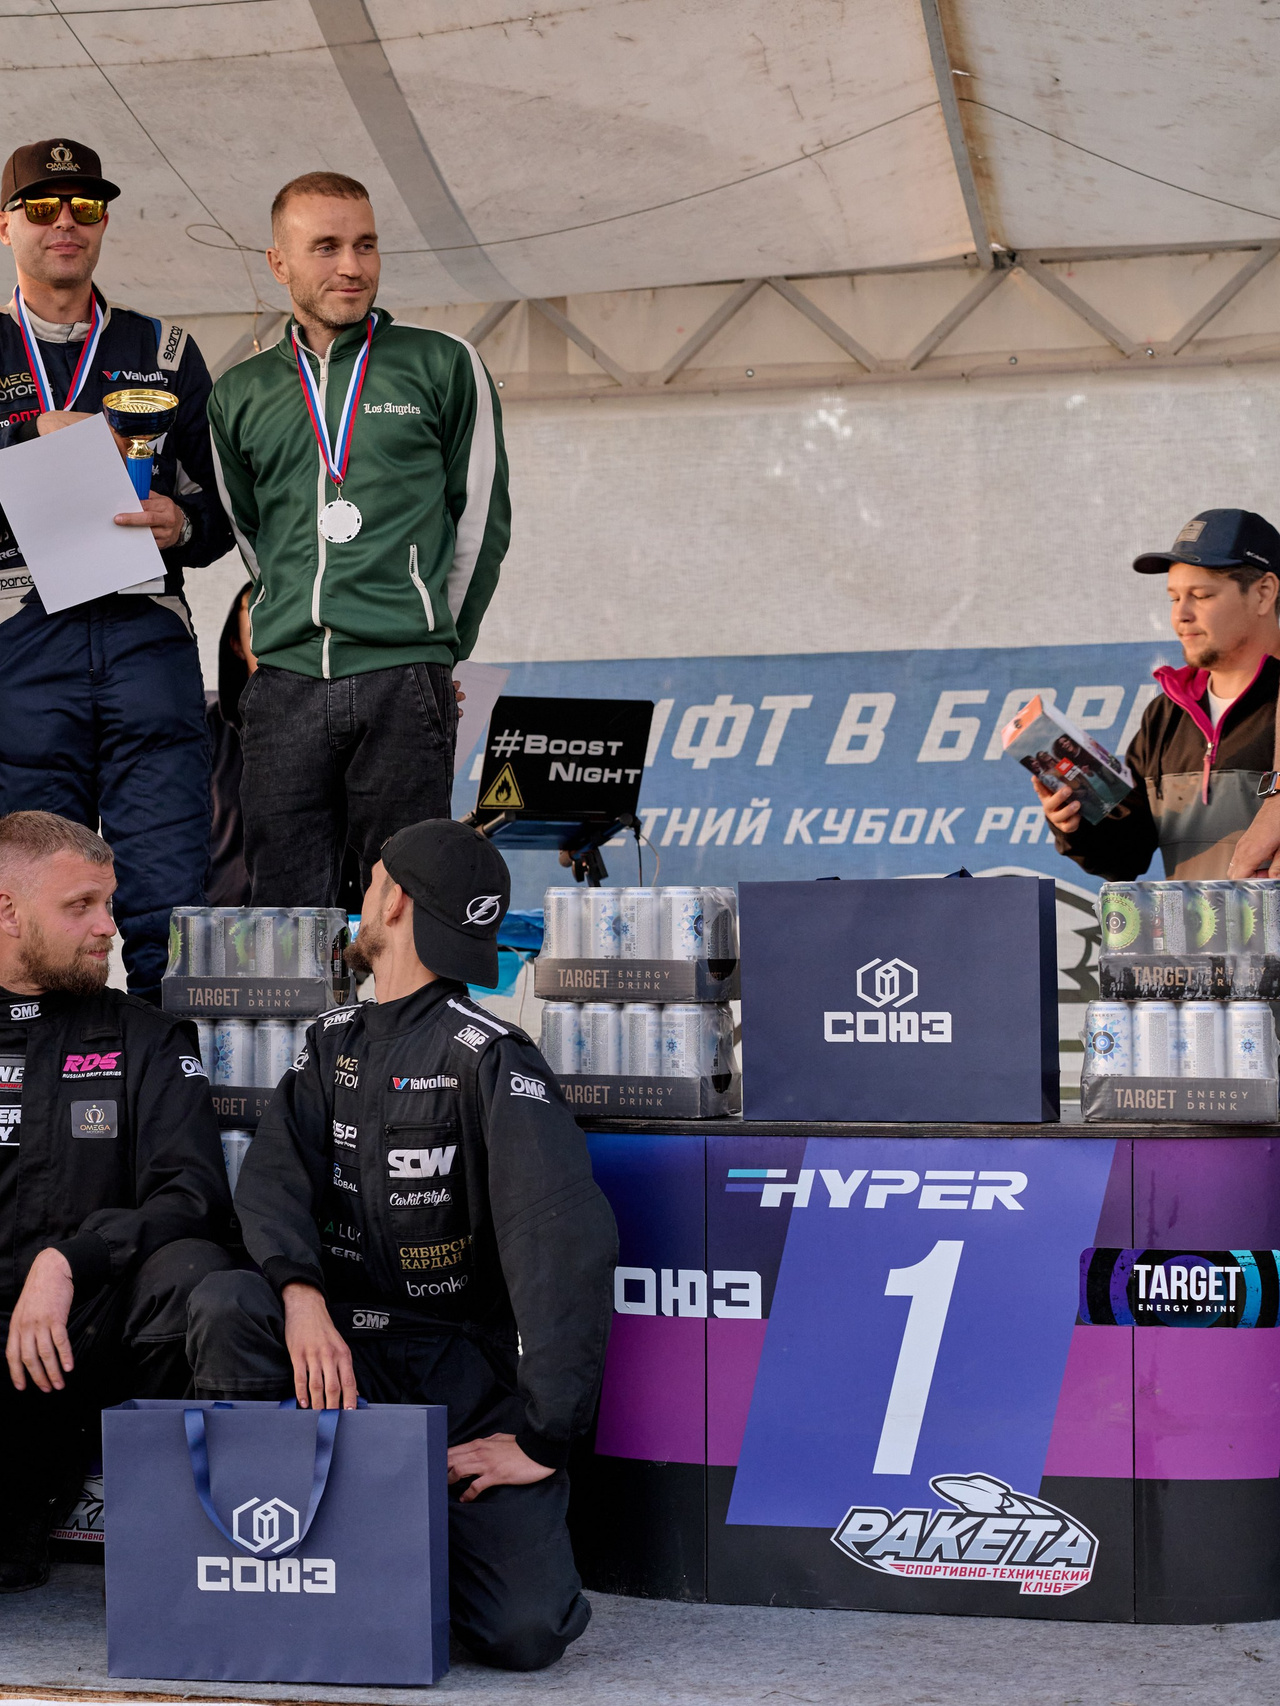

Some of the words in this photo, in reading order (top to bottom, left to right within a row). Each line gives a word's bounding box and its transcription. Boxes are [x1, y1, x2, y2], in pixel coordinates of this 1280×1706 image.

[363, 403, 383, 414] Los
[384, 402, 421, 416] Angeles
[825, 692, 897, 765] В
[783, 807, 966, 845] КУБОК
[558, 968, 609, 989] TARGET
[618, 970, 671, 979] ENERGY
[618, 981, 660, 990] DRINK
[1133, 966, 1195, 987] TARGET
[187, 988, 240, 1007] TARGET
[248, 988, 301, 997] ENERGY
[248, 999, 291, 1008] DRINK
[10, 1003, 40, 1019] OMP
[456, 1025, 487, 1050] OMP
[825, 1011, 953, 1044] СОЮЗ
[62, 1051, 122, 1073] RDS
[410, 1074, 458, 1090] Valvoline
[510, 1075, 546, 1100] OMP
[620, 1086, 673, 1095] ENERGY
[620, 1097, 663, 1106] DRINK
[1114, 1088, 1177, 1109] TARGET
[1187, 1090, 1249, 1099] ENERGY
[1187, 1101, 1237, 1110] DRINK
[387, 1145, 457, 1178] SCW
[423, 1187, 451, 1206] Style
[760, 1169, 1029, 1211] HYPER
[401, 1251, 463, 1271] КАРДАН
[406, 1274, 469, 1298] bronko
[614, 1266, 762, 1319] ОЮЗ
[1133, 1264, 1242, 1301] TARGET
[1138, 1303, 1189, 1312] ENERGY
[1196, 1304, 1236, 1313] DRINK
[352, 1311, 390, 1329] OMP
[872, 1239, 965, 1476] 1
[837, 1508, 1093, 1566] РАКЕТА
[197, 1556, 337, 1594] СОЮЗ
[905, 1563, 1089, 1581] СПОРТИВНО-ТЕХНИЧЕСКИЙ
[1023, 1581, 1062, 1593] КЛУБ
